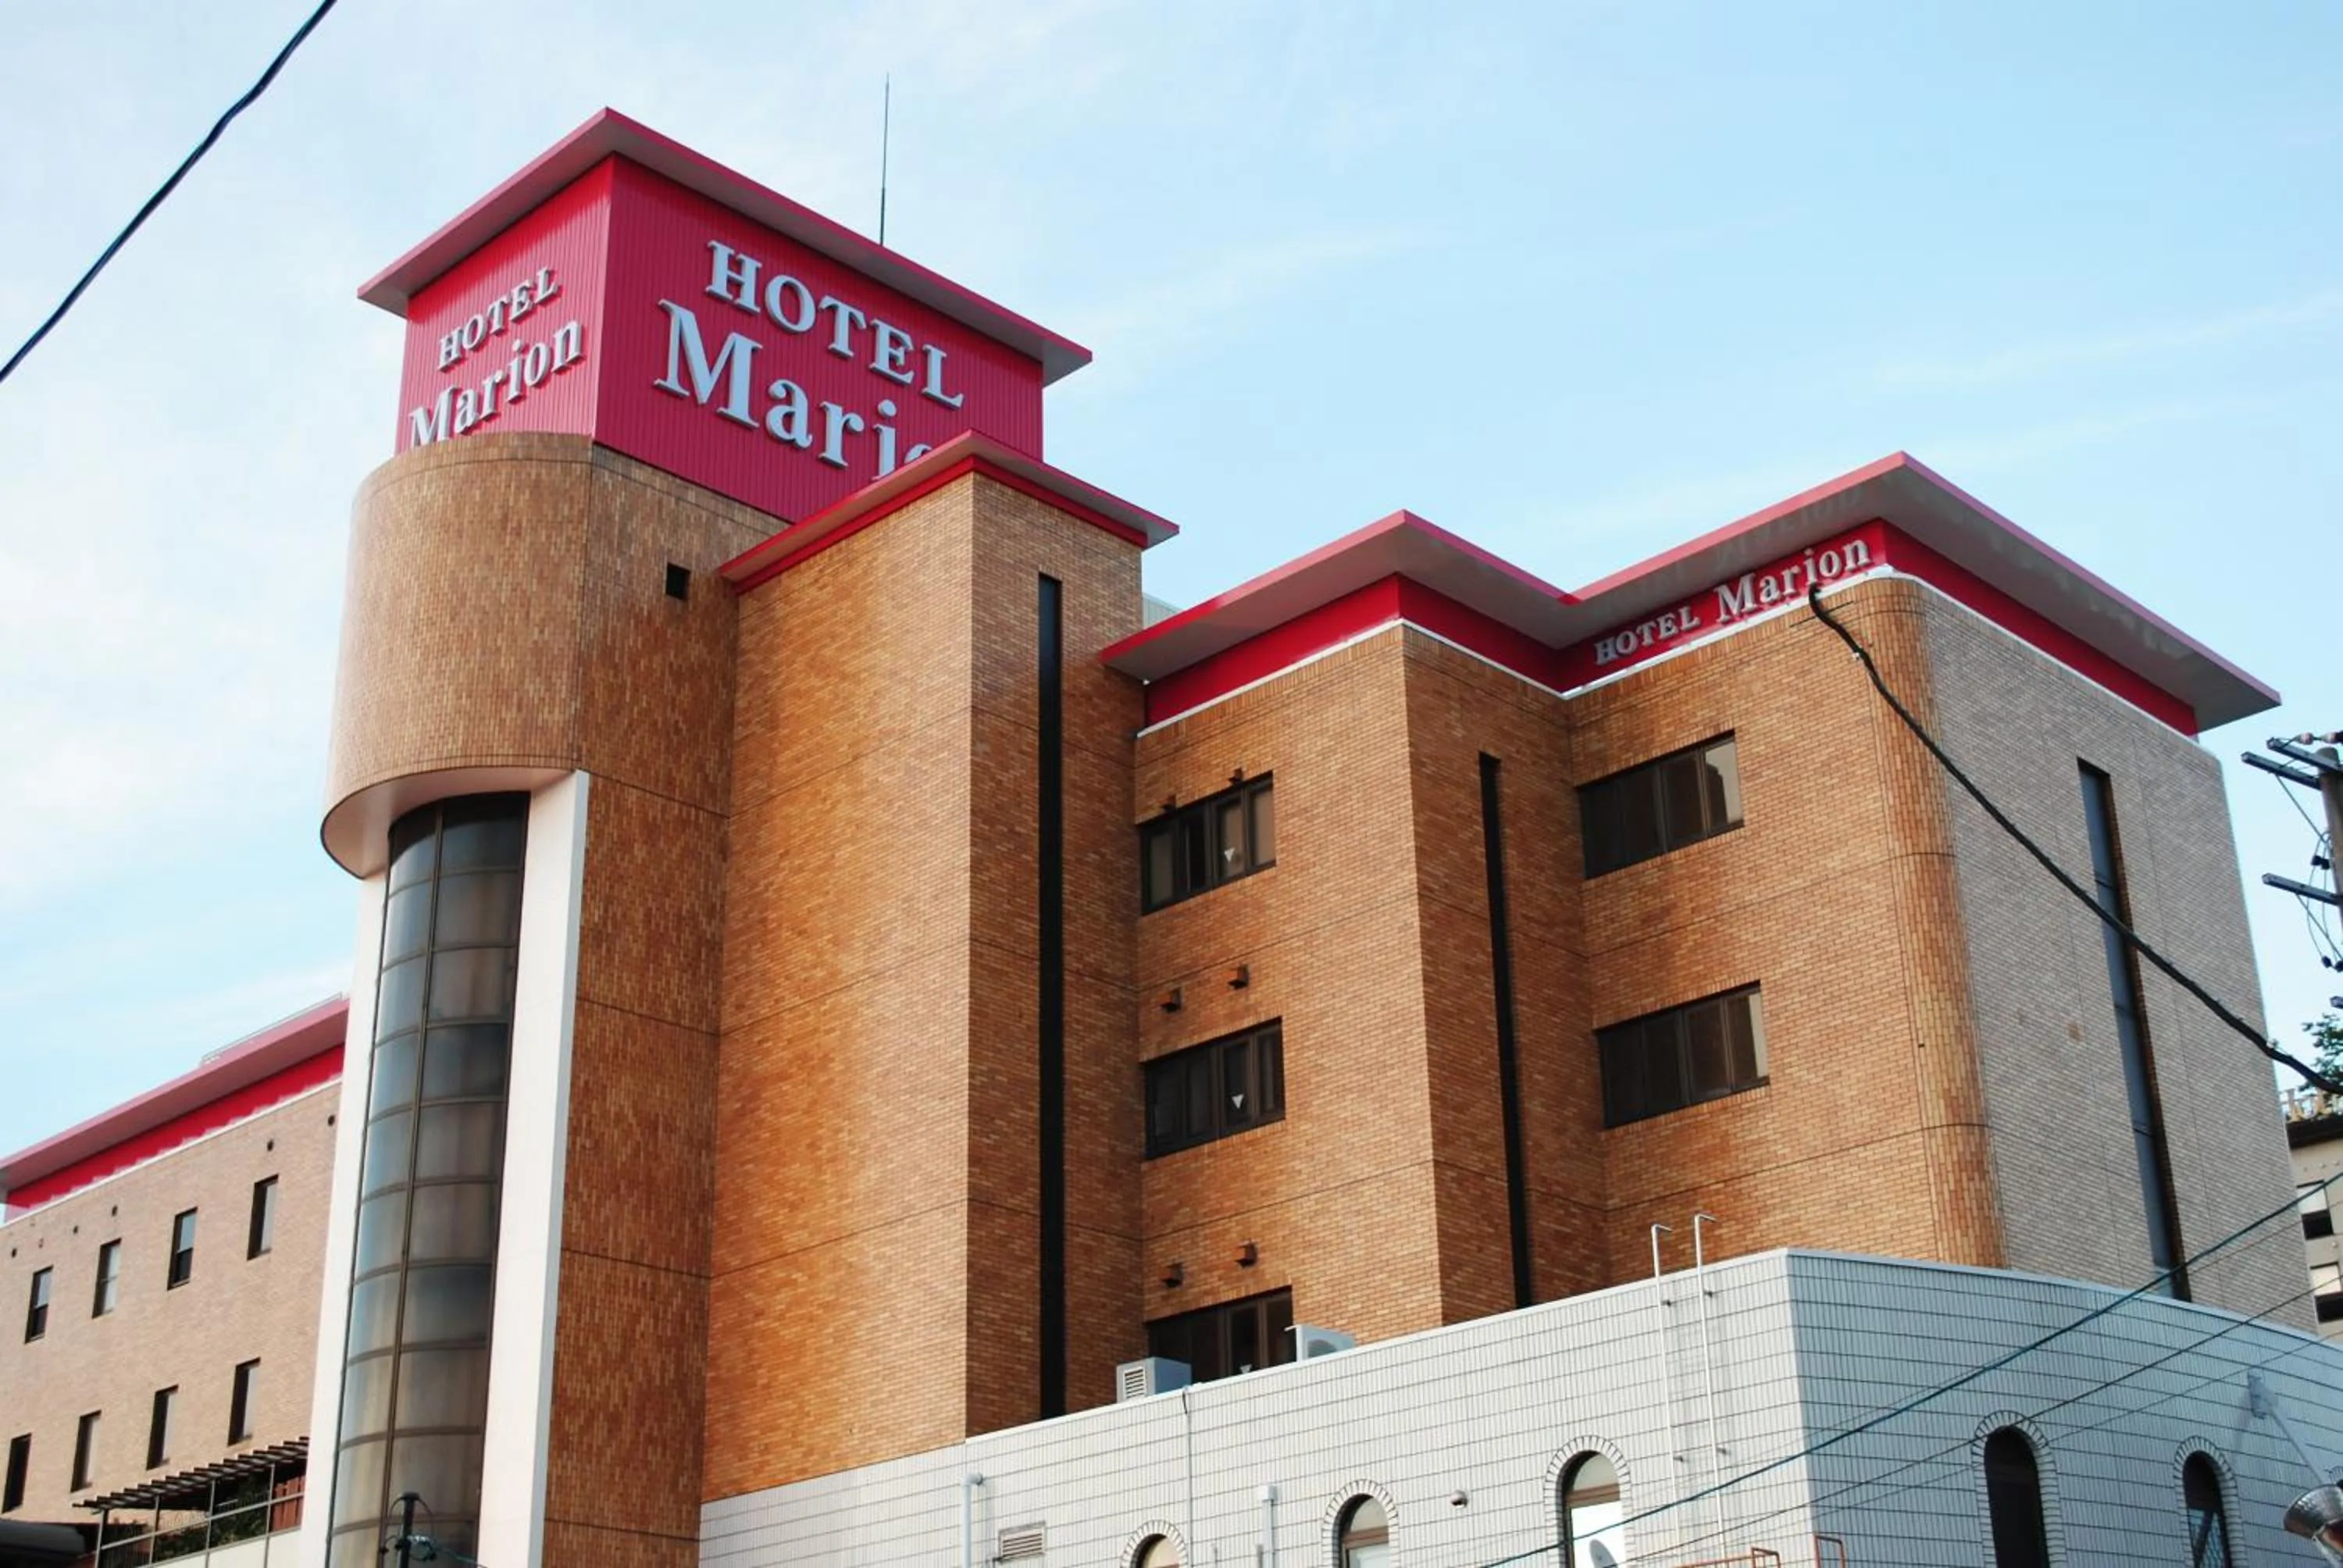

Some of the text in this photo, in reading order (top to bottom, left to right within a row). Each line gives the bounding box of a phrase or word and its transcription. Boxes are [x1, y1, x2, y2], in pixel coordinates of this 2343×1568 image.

[437, 266, 559, 372] HOTEL
[704, 240, 965, 409] HOTEL
[408, 320, 583, 447] Marion
[653, 298, 934, 481] Mari
[1595, 539, 1871, 665] HOTEL Marion
